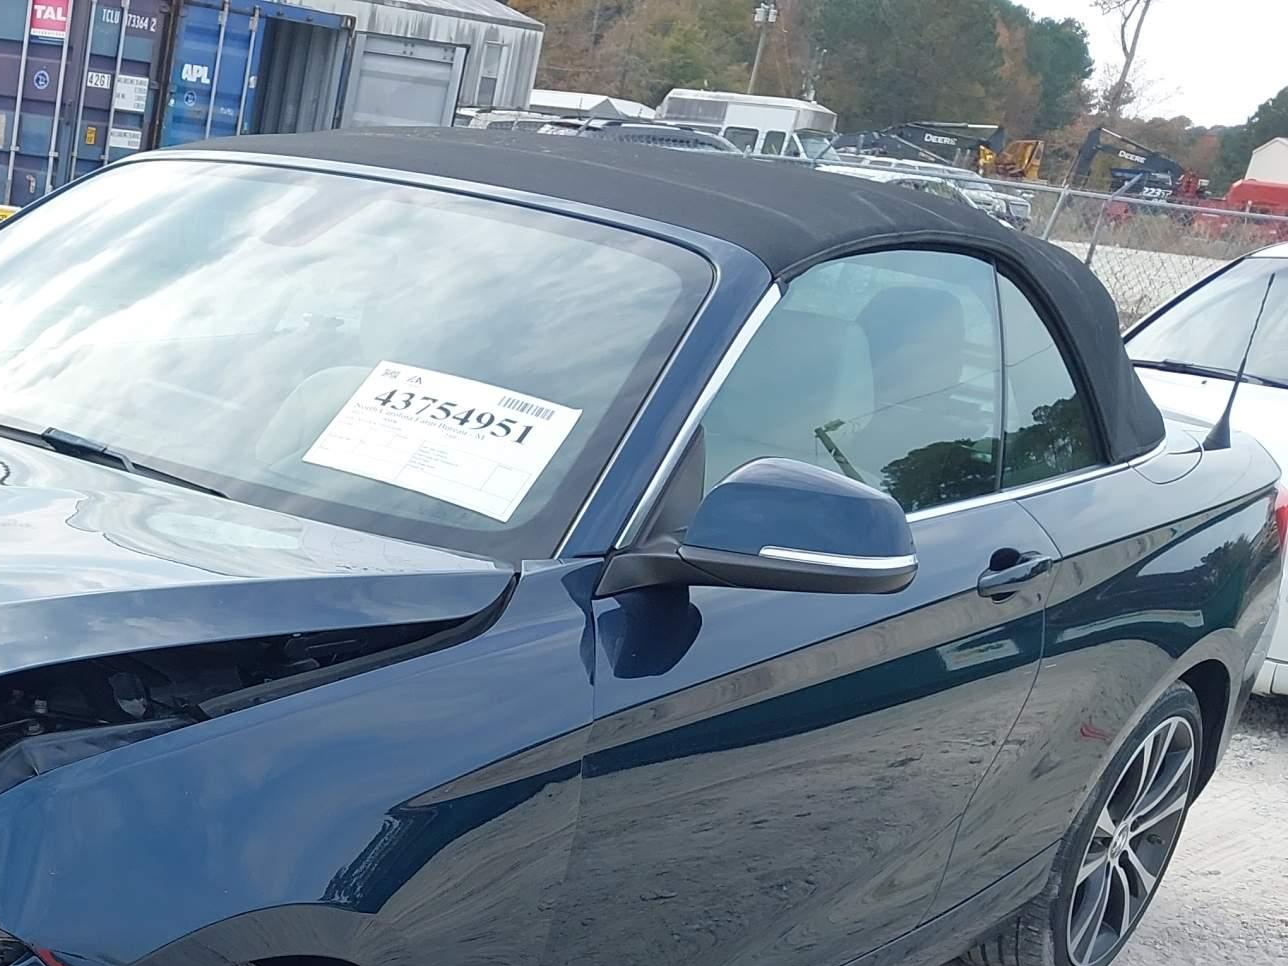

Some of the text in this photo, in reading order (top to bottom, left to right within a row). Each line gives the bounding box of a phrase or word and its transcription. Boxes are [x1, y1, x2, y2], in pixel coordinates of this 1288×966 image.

[33, 4, 67, 21] TAL
[101, 8, 120, 24] TCLU
[87, 73, 111, 88] 42G1
[181, 63, 211, 84] APL
[924, 133, 958, 146] DEERE
[1118, 150, 1147, 164] DEERE
[374, 388, 534, 445] 43754951
